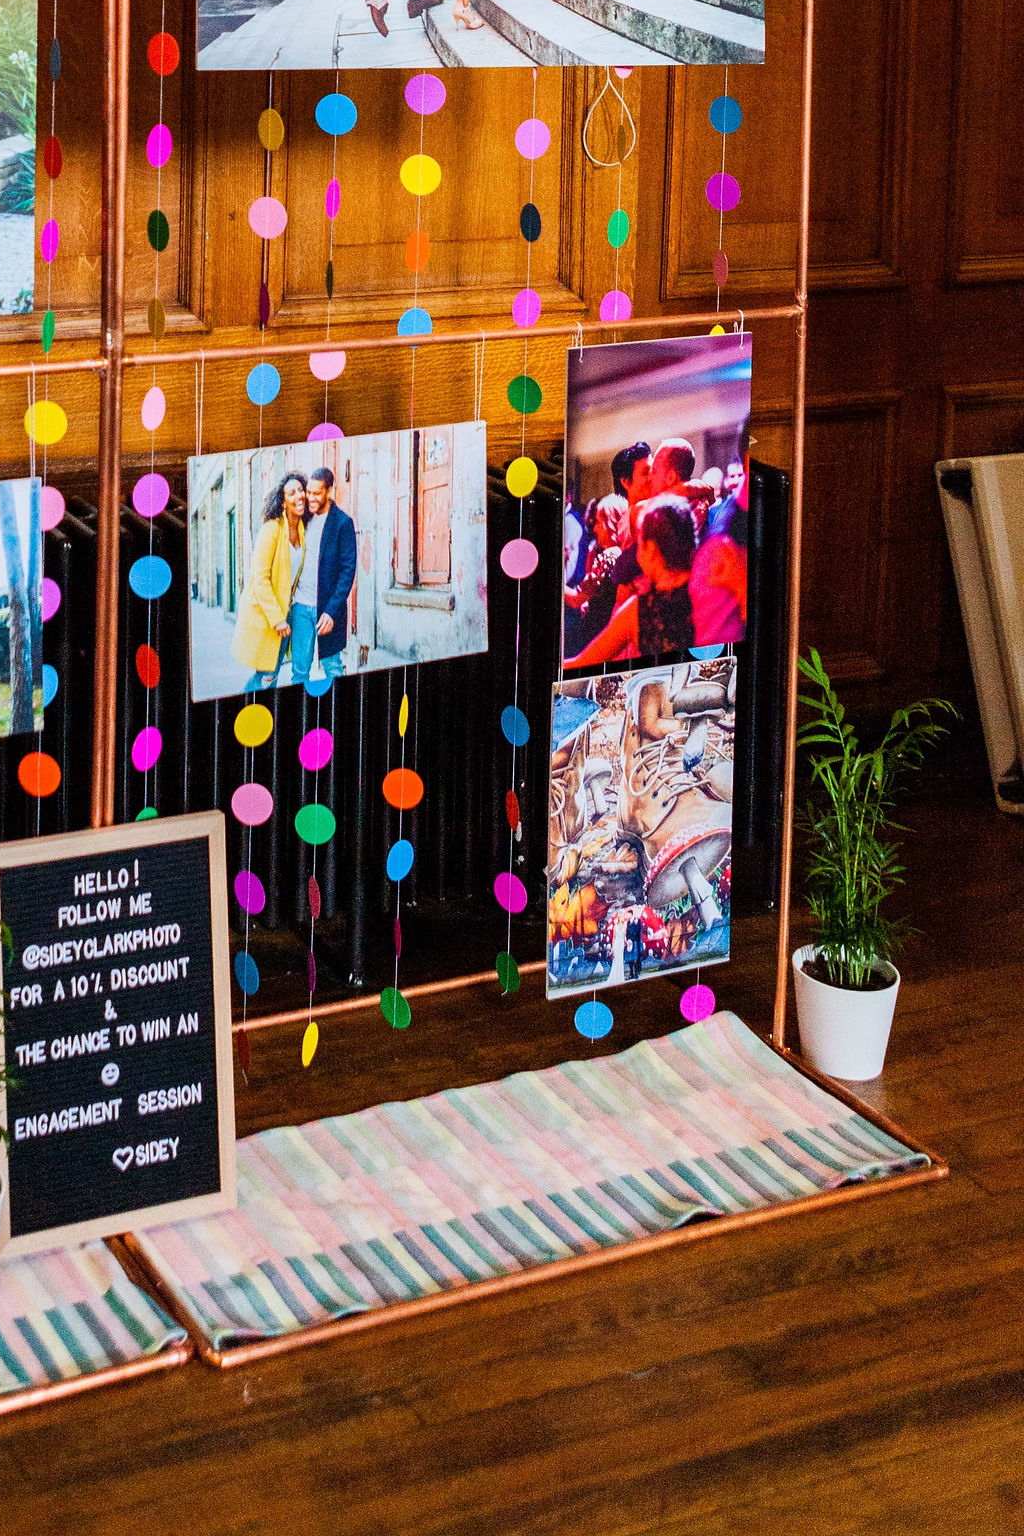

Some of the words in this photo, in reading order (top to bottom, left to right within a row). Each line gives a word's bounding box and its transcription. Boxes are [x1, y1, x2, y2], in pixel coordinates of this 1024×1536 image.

[57, 898, 123, 929] FOLLOW
[129, 892, 153, 917] ME
[22, 923, 181, 970] @SIDEYCLARKPHOTO
[10, 983, 43, 1010] FOR
[110, 956, 190, 991] DISCOUNT
[104, 999, 118, 1021] &
[15, 1040, 47, 1067] THE
[50, 1027, 111, 1060] CHANCE
[115, 1023, 137, 1047] TO
[140, 1016, 171, 1043] WIN
[176, 1012, 199, 1036] AN
[14, 1097, 123, 1141] ENGAGEMENT
[137, 1082, 202, 1115] SESSION
[135, 1136, 180, 1166] SIDEY
